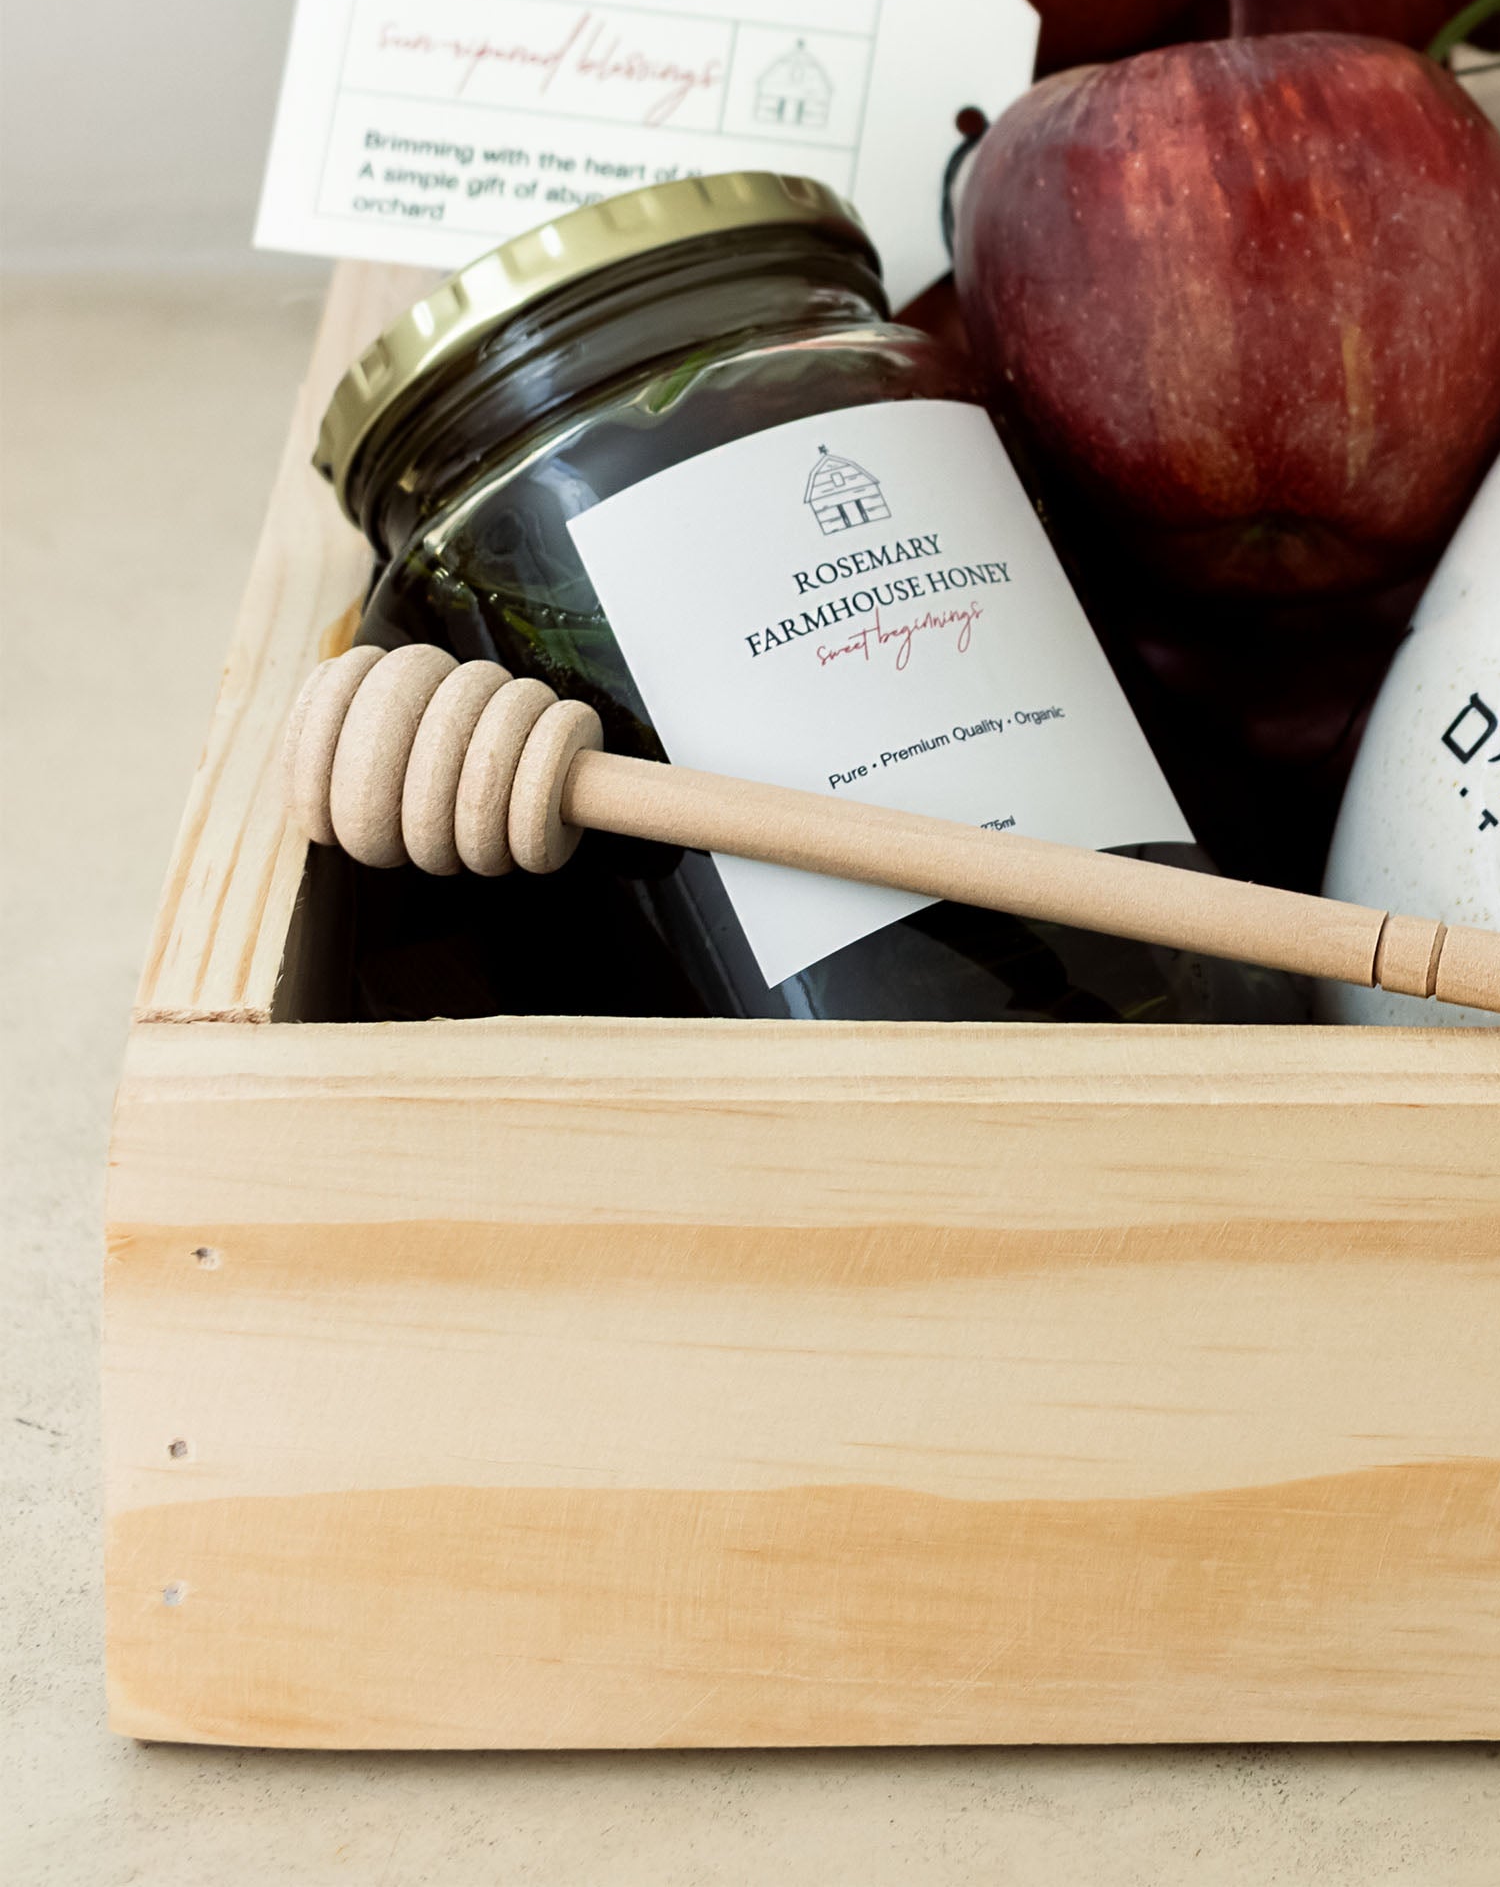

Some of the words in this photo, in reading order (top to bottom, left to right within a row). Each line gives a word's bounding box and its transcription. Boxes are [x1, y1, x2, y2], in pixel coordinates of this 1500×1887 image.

[575, 17, 724, 128] blessings
[358, 160, 375, 180] A
[383, 164, 460, 192] simple
[466, 171, 506, 198] gift
[513, 179, 539, 200] of
[364, 129, 475, 164] Brimming
[482, 148, 531, 167] with
[539, 152, 577, 174] the
[584, 157, 646, 181] heart
[654, 165, 679, 183] of
[352, 191, 445, 221] orchard
[791, 533, 943, 595] ROSEMARY
[744, 576, 926, 658] FARMHOUSE
[923, 561, 1013, 594] HONEY
[816, 625, 877, 666] sweet
[874, 603, 984, 671] beginnings
[827, 764, 869, 790] Pure
[879, 733, 951, 768] Premium
[951, 717, 1005, 743] Quality
[1013, 704, 1067, 726] Organic
